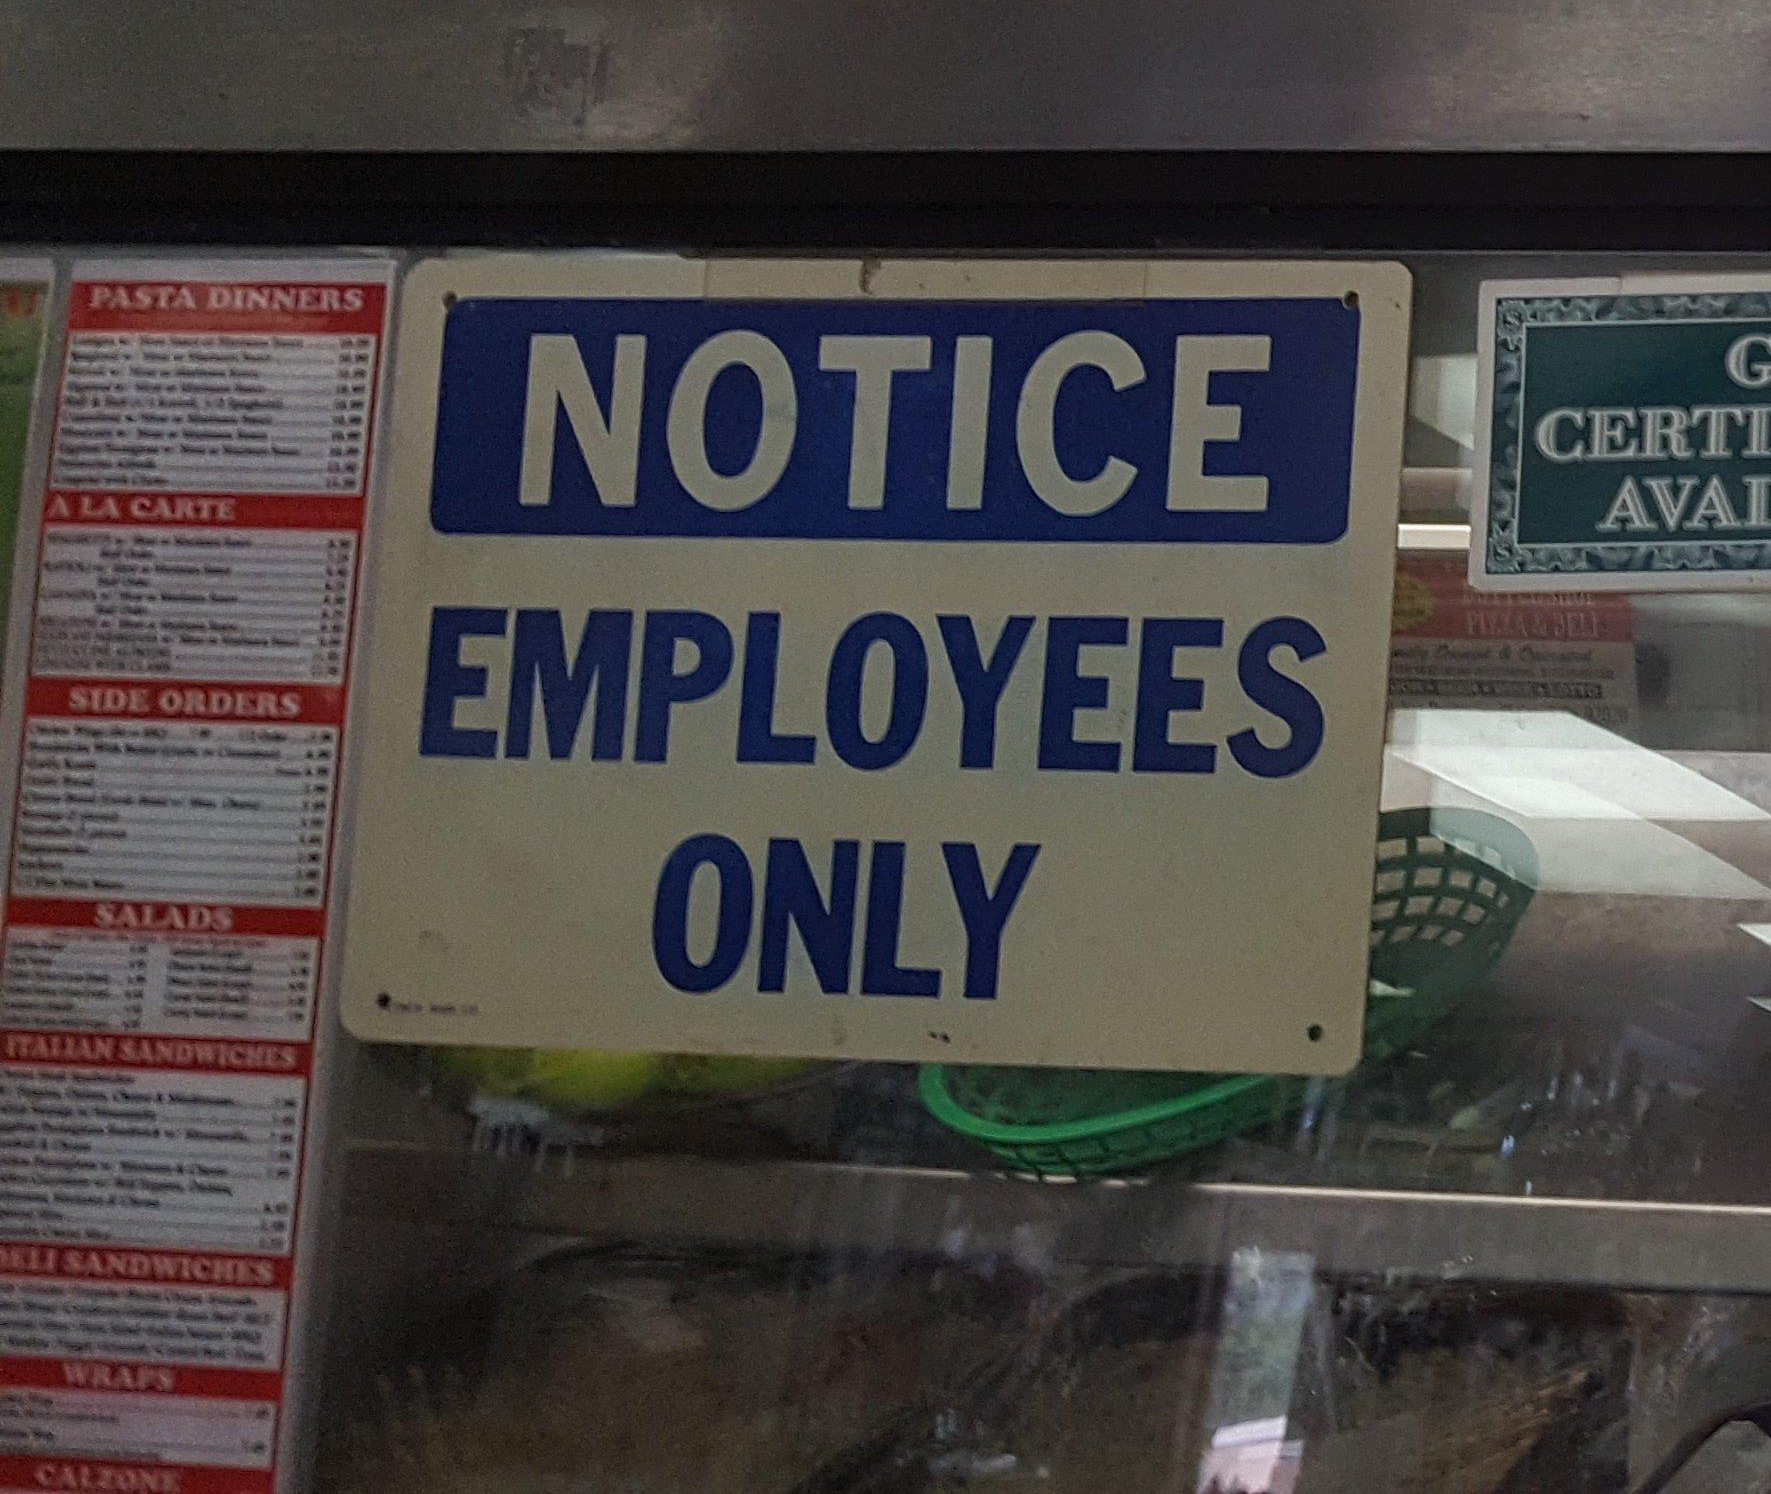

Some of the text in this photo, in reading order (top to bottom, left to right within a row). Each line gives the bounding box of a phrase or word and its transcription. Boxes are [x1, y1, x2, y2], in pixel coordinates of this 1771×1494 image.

[90, 287, 364, 312] PASTA DINNERS
[519, 330, 1271, 515] NOTICE
[49, 496, 236, 521] A LA CARTE
[70, 688, 301, 717] SIDE ORDERS
[418, 606, 1326, 779] EMPLOYEES
[95, 906, 234, 931] SALADS
[652, 834, 1041, 1000] ONLY
[5, 1034, 295, 1068] ITALIAN SANDWICHES
[0, 1247, 275, 1286] ELI SANDWICHES
[63, 1362, 175, 1390] WRAPS
[35, 1464, 180, 1491] CALZONE
